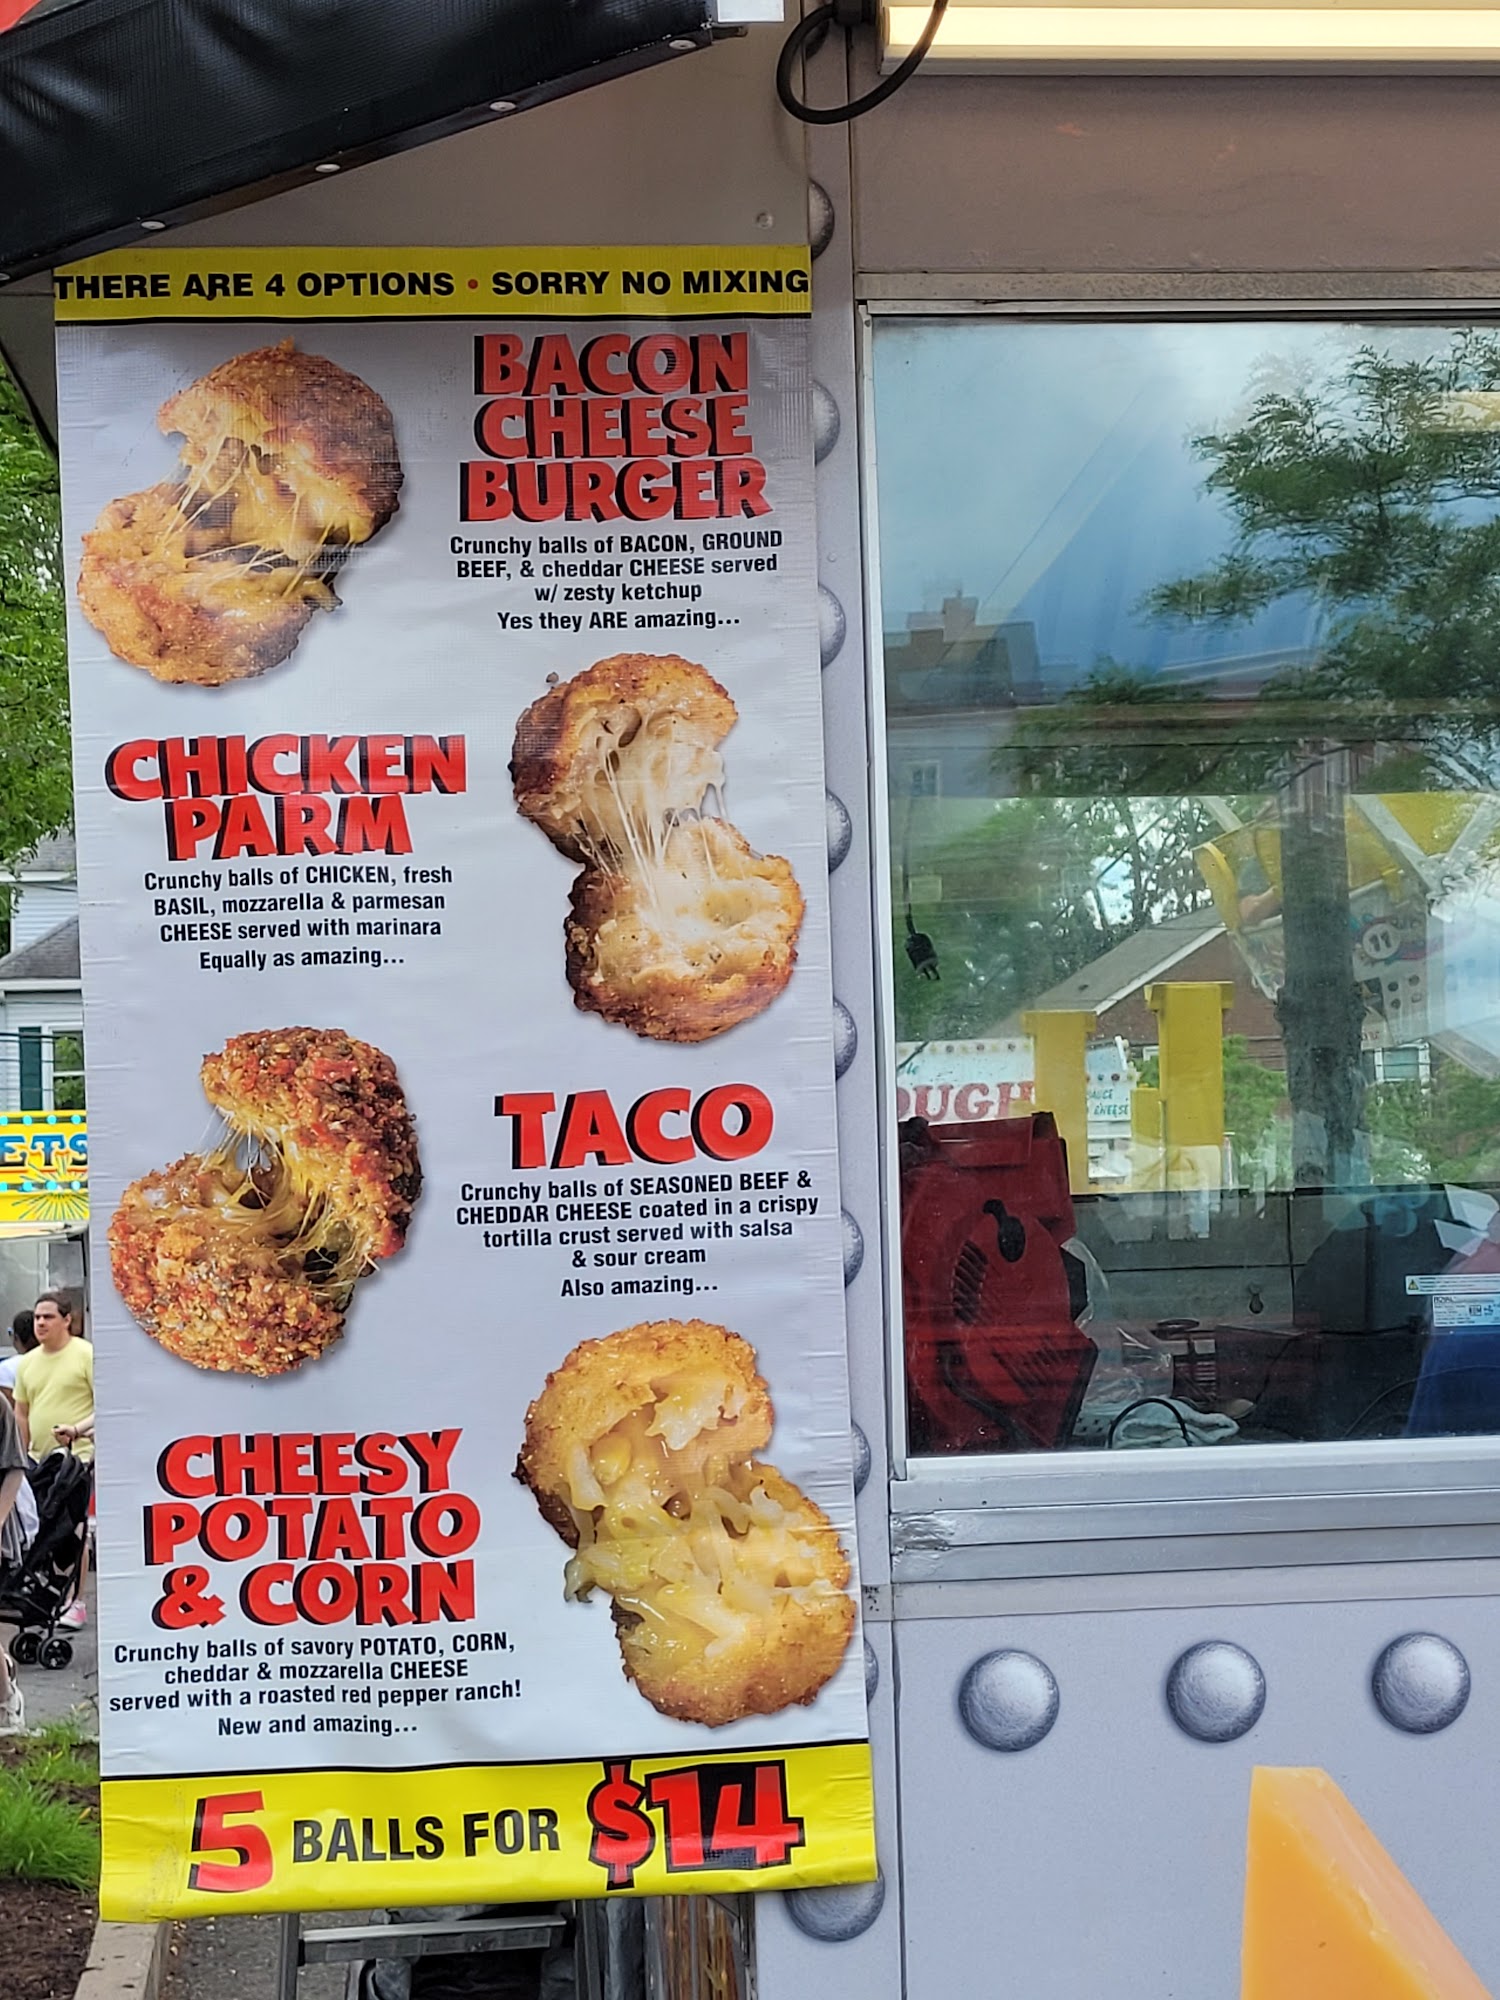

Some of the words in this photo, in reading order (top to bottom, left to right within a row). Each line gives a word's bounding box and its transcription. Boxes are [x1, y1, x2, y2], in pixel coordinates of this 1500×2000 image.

[53, 274, 171, 300] THERE
[182, 273, 254, 300] ARE
[265, 273, 286, 297] 4
[297, 271, 455, 297] OPTIONS
[492, 271, 611, 295] SORRY
[622, 270, 672, 295] NO
[682, 269, 810, 294] MIXING
[474, 331, 748, 396] BACON
[474, 394, 753, 459] CHEESE
[459, 458, 774, 523] BURGER
[450, 536, 532, 558] Crunchy
[539, 535, 587, 554] balls
[593, 534, 613, 553] of
[620, 534, 695, 555] BACON,
[702, 530, 783, 551] GROUND
[457, 560, 512, 581] BEEF,
[519, 560, 535, 578] &
[542, 559, 623, 578] cheddar
[629, 557, 705, 577] CHEESE
[711, 554, 777, 574] served
[535, 584, 557, 603] w/
[563, 584, 615, 604] zesty
[621, 581, 703, 602] ketchup
[497, 611, 533, 630] Yes
[539, 611, 582, 633] they
[589, 611, 628, 630] ARE
[104, 733, 466, 802] CHICKEN
[164, 793, 413, 862] PARM
[144, 871, 222, 892] Crunchy
[228, 867, 273, 888] balls
[280, 866, 299, 886] of
[305, 865, 397, 886] CHICKEN,
[403, 865, 452, 884] fresh
[154, 897, 216, 918] BASIL,
[222, 893, 324, 914] mozzarella
[331, 892, 345, 911] &
[352, 894, 446, 913] parmesan
[160, 922, 232, 943] CHEESE
[237, 920, 301, 940] served
[307, 918, 350, 937] with
[356, 917, 442, 936] marinara
[200, 950, 266, 972] Equally
[273, 953, 295, 968] as
[494, 1083, 774, 1170] TACO
[461, 1182, 542, 1204] Crunchy
[548, 1179, 597, 1199] balls
[604, 1177, 624, 1197] of
[630, 1174, 733, 1196] SEASONED
[740, 1171, 789, 1191] BEEF
[797, 1170, 812, 1188] &
[456, 1204, 549, 1226] CHEDDAR
[556, 1201, 632, 1221] CHEESE
[639, 1198, 707, 1219] coated
[715, 1197, 733, 1216] in
[739, 1201, 751, 1215] a
[758, 1194, 819, 1216] crispy
[483, 1228, 552, 1248] tortilla
[559, 1225, 611, 1245] crust
[617, 1223, 683, 1243] served
[690, 1221, 733, 1240] with
[739, 1219, 793, 1238] salsa
[572, 1250, 587, 1268] &
[593, 1252, 637, 1267] sour
[644, 1249, 706, 1265] cream
[561, 1277, 604, 1297] Also
[156, 1428, 463, 1498] CHEESY
[143, 1492, 481, 1566] POTATO
[151, 1564, 227, 1630] &
[239, 1559, 476, 1626] CORN
[114, 1642, 199, 1664] Crunchy
[207, 1639, 257, 1658] balls
[264, 1637, 284, 1656] of
[291, 1640, 354, 1660] savory
[360, 1637, 444, 1658] POTATO,
[452, 1632, 515, 1654] CORN,
[164, 1664, 249, 1685] cheddar
[257, 1662, 273, 1680] &
[279, 1662, 384, 1680] mozzarella
[390, 1659, 469, 1680] CHEESE
[109, 1691, 180, 1712] served
[187, 1688, 232, 1708] with
[239, 1691, 251, 1705] a
[258, 1685, 336, 1705] roasted
[342, 1683, 371, 1703] red
[378, 1686, 449, 1708] pepper
[455, 1679, 521, 1701] ranch!
[218, 1717, 262, 1736] New
[268, 1714, 306, 1734] and
[188, 1790, 274, 1893] 5
[292, 1815, 445, 1864] BALLS
[463, 1808, 560, 1857] FOR
[587, 1758, 806, 1891] $14
